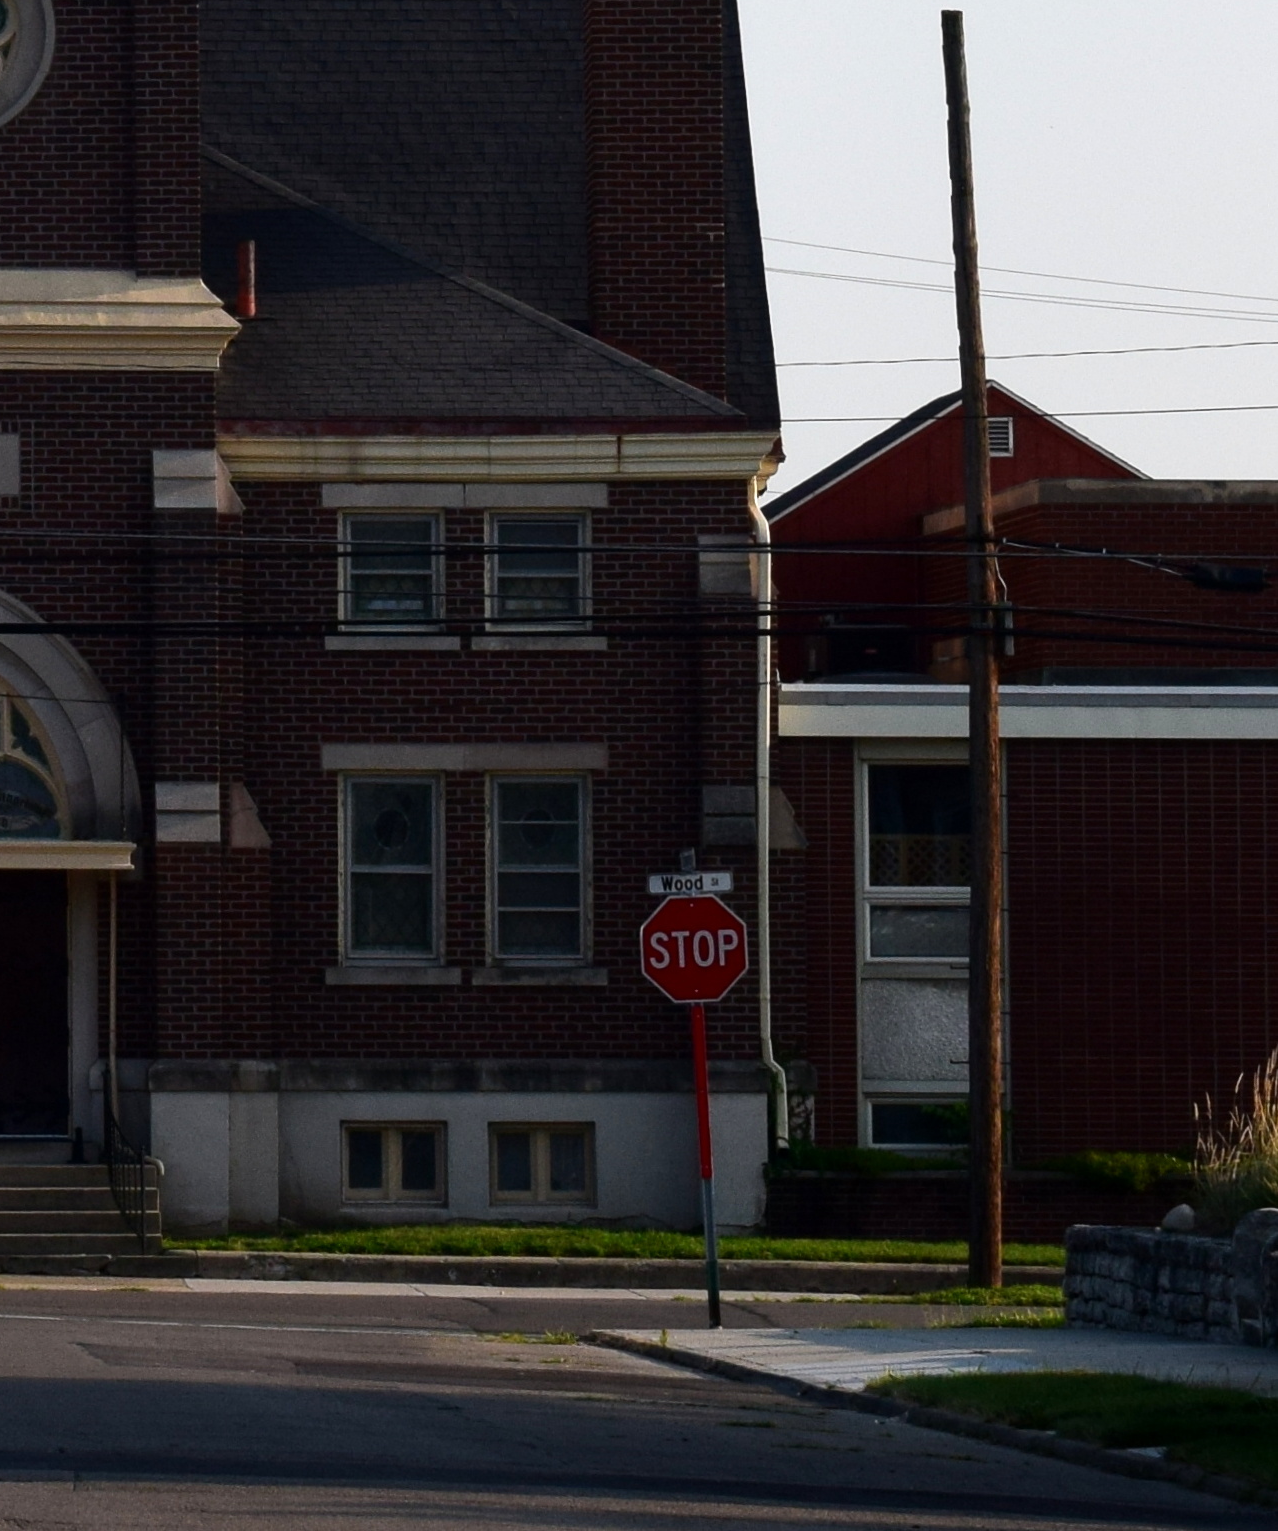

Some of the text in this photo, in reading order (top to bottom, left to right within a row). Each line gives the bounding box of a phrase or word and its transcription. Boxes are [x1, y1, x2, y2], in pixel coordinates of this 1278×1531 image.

[661, 874, 720, 891] Wood St
[649, 928, 739, 969] STOP
